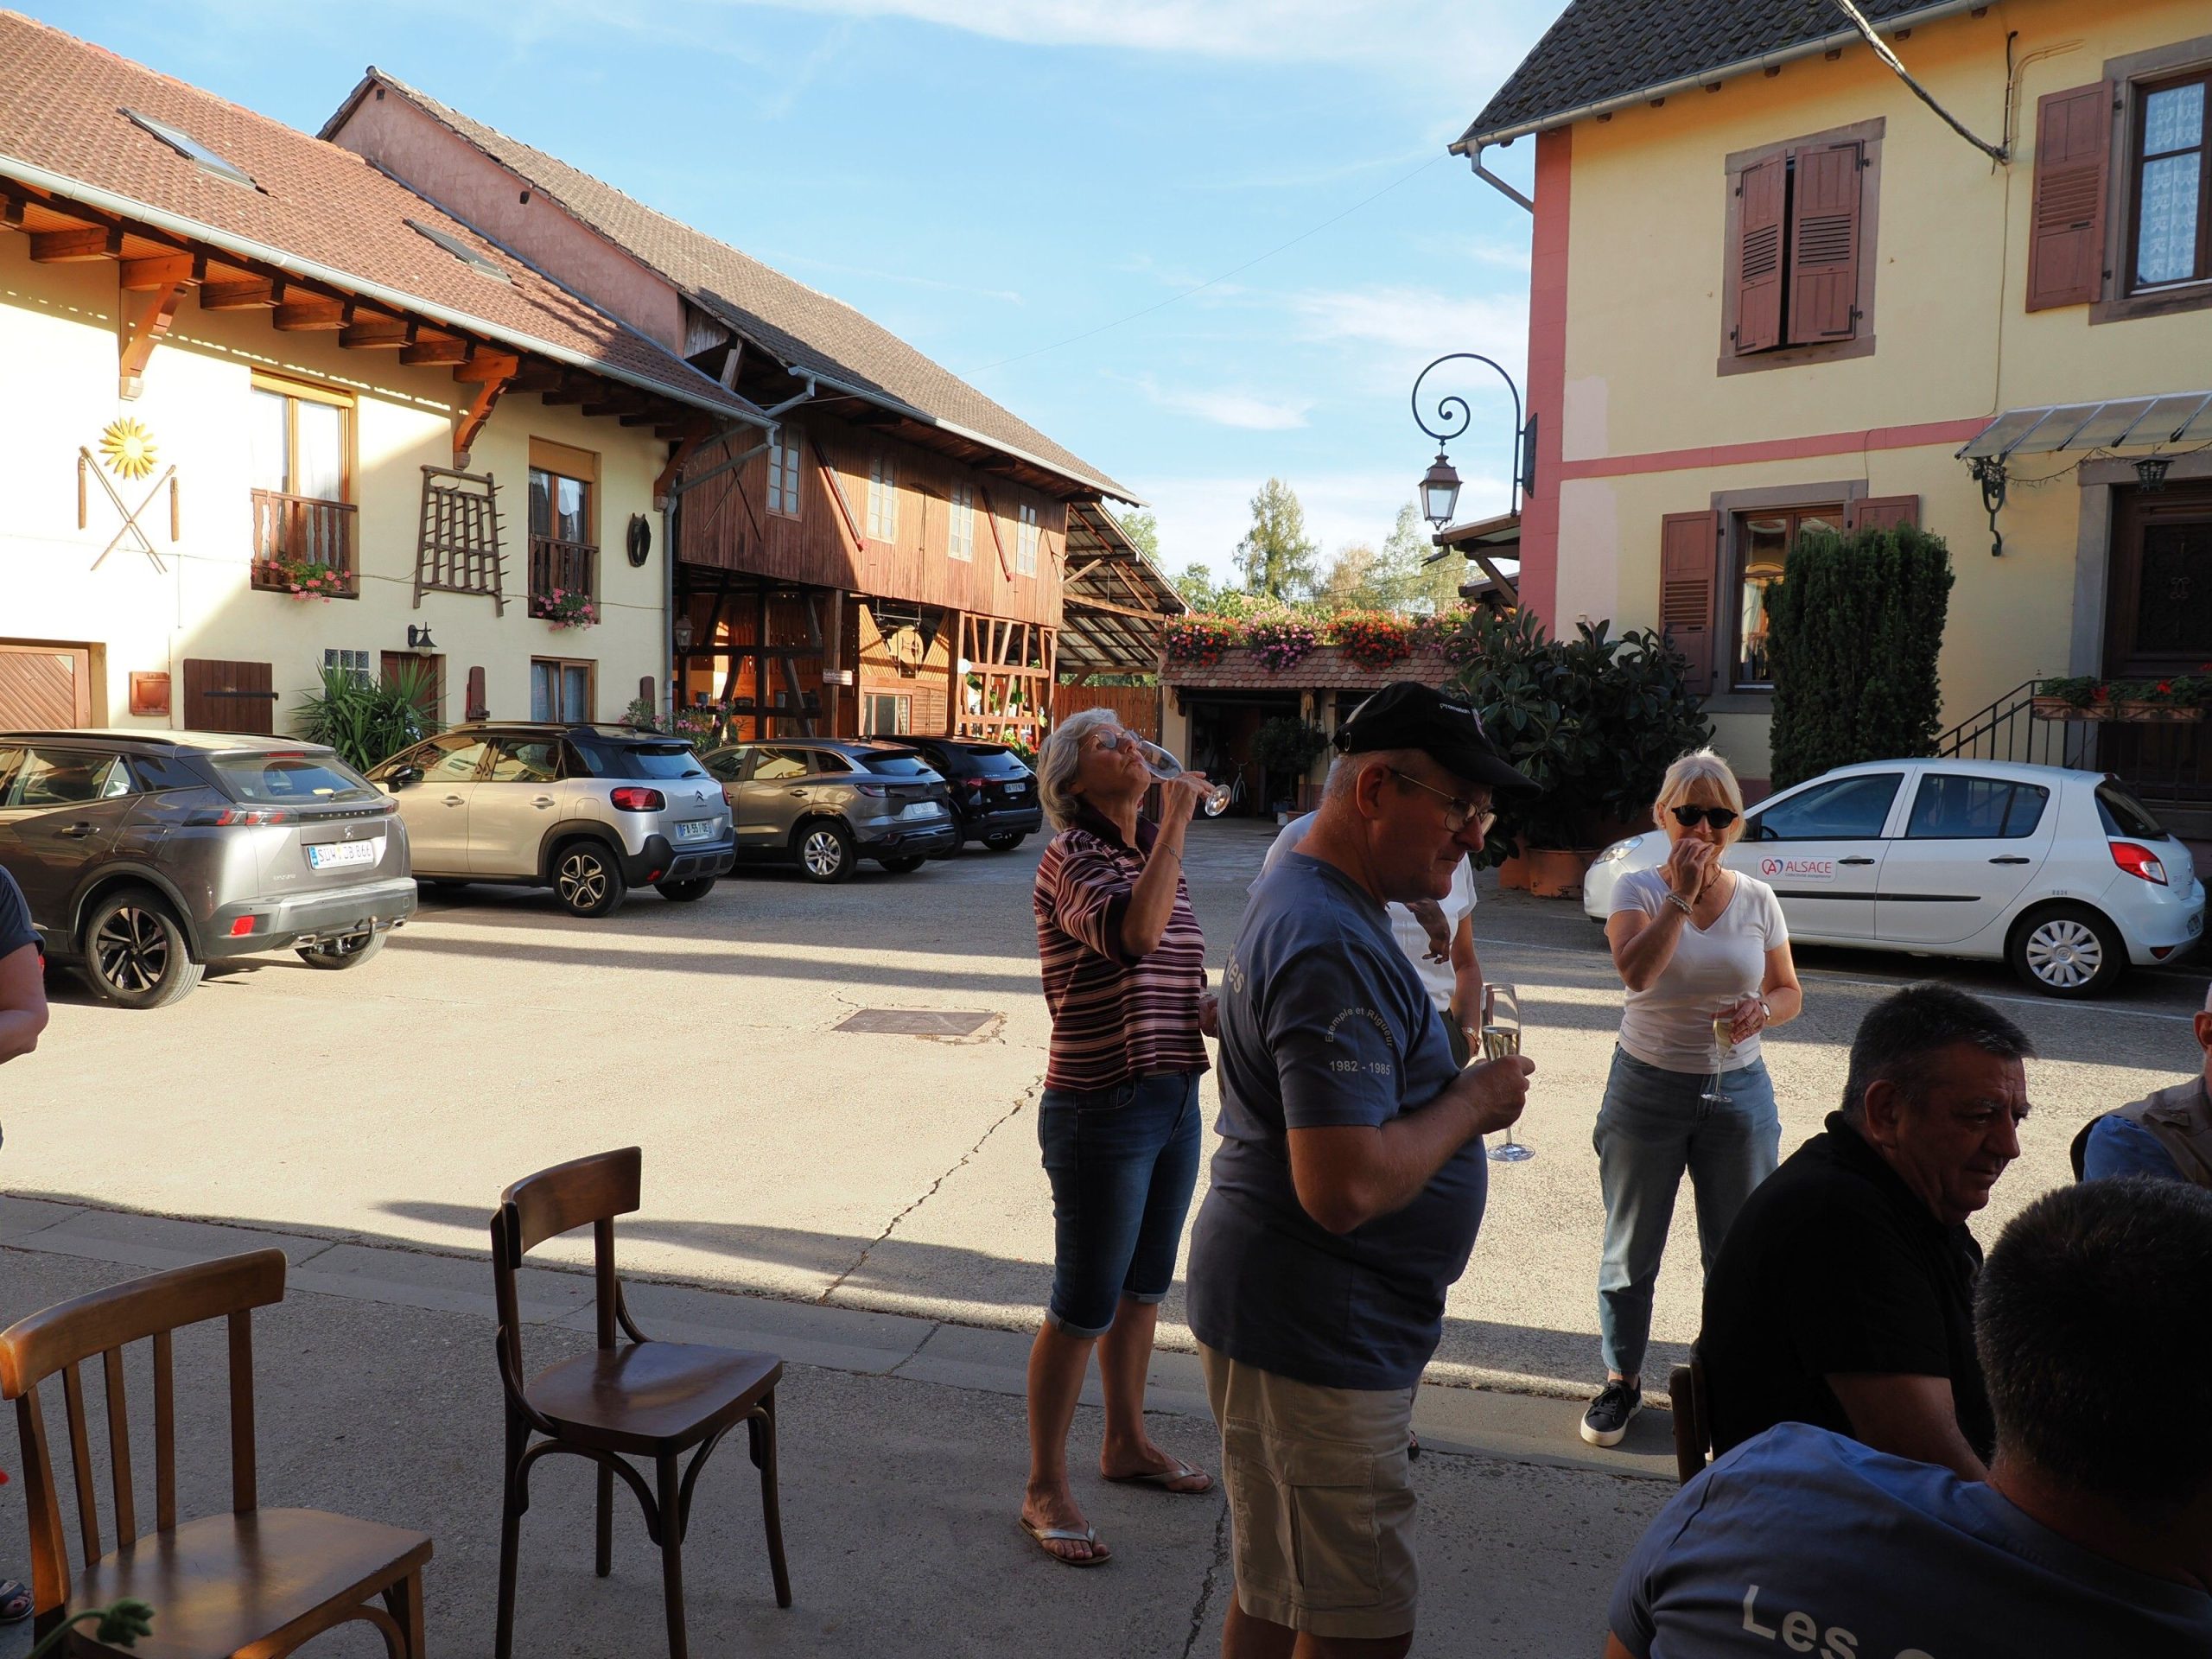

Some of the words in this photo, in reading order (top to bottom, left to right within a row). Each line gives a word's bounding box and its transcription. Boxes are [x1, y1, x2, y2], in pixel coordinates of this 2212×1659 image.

[1785, 861, 1832, 874] ALSACE
[1325, 1008, 1353, 1043] Exemple
[1355, 1007, 1365, 1015] et
[1367, 1009, 1393, 1048] Rigueur
[1329, 1060, 1358, 1072] 1982
[1369, 1062, 1390, 1076] 1985
[1742, 1584, 1859, 1659] Les
